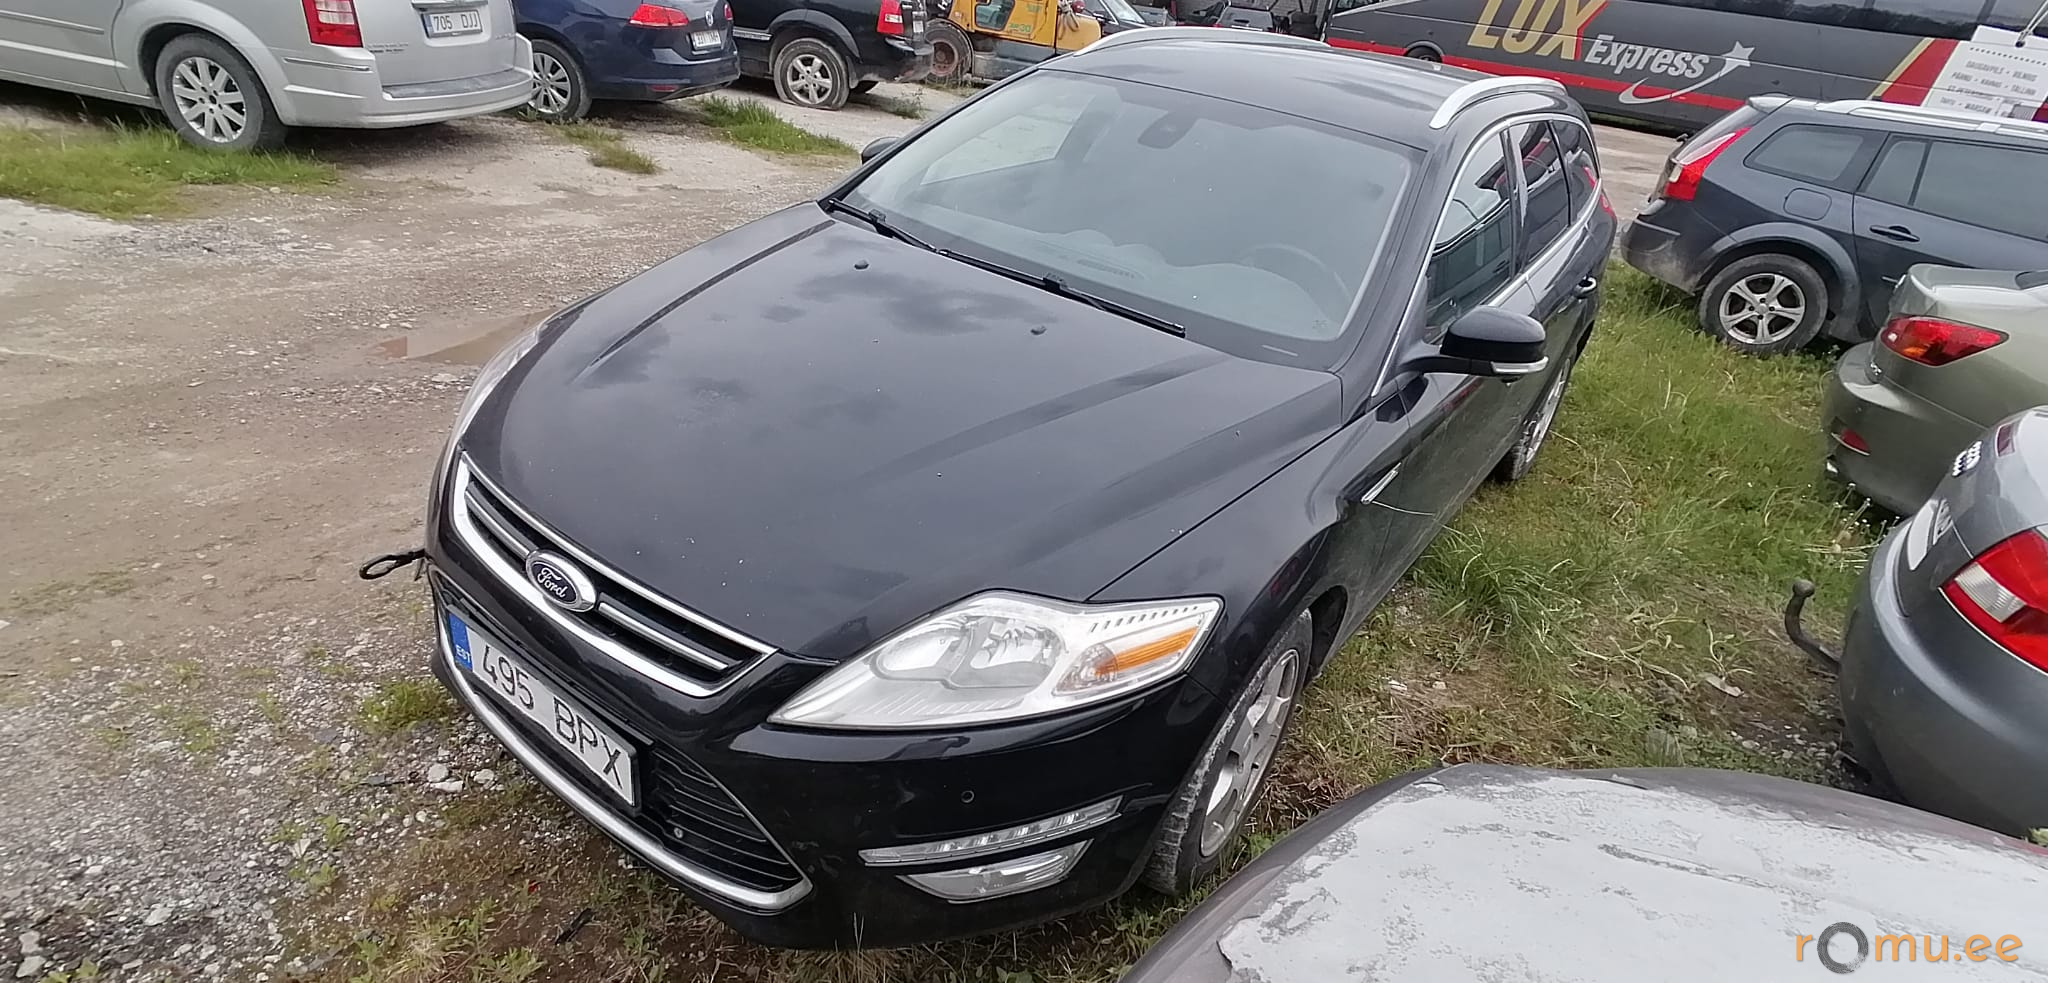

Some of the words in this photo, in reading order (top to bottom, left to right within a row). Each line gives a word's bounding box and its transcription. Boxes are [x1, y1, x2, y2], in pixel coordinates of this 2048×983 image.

[433, 15, 453, 31] 705
[461, 13, 478, 29] DJJ
[1467, 0, 1607, 60] LUX
[1584, 34, 1709, 79] Express
[536, 566, 567, 599] Ford
[455, 643, 471, 664] EST
[482, 645, 534, 710] 495
[553, 696, 623, 790] BPX
